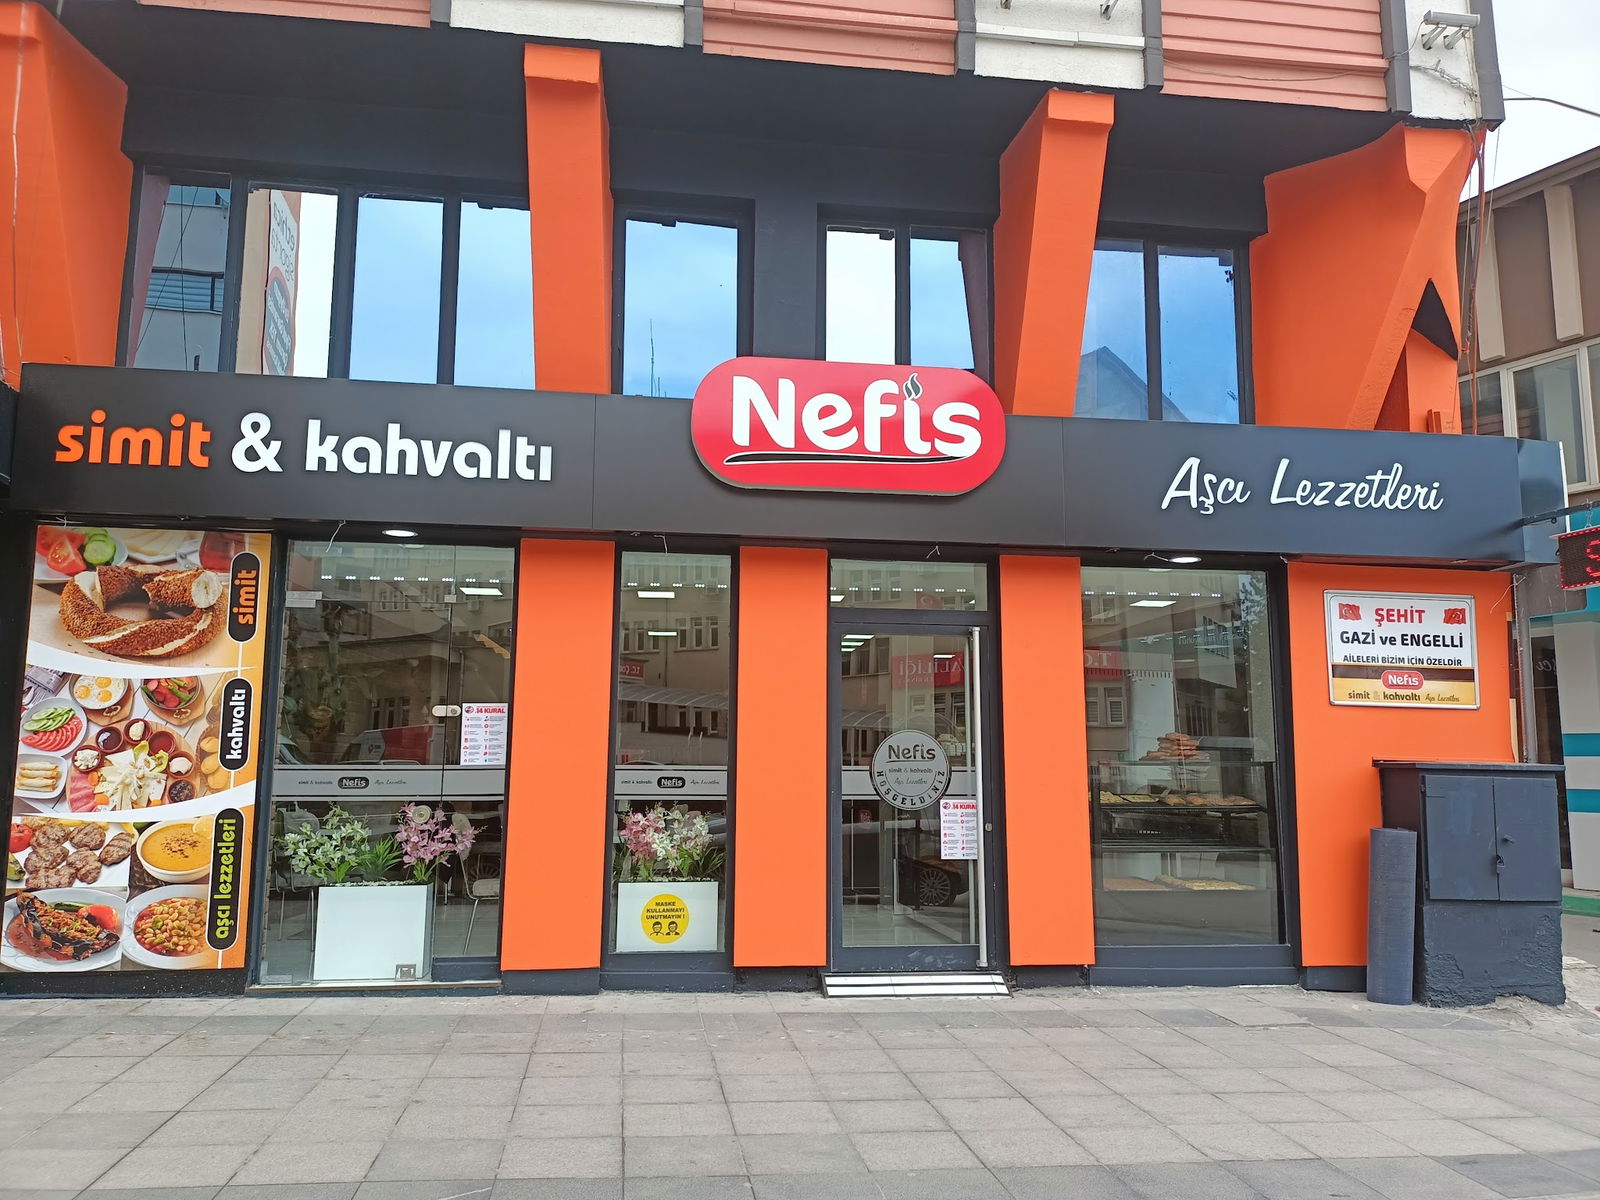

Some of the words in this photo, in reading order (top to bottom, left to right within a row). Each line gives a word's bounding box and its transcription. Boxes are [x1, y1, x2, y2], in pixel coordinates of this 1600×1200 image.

[732, 374, 983, 458] Nefis
[54, 408, 212, 468] simit
[231, 412, 284, 473] &
[305, 418, 553, 482] kahvaltı
[1161, 456, 1251, 515] Aşcı
[1270, 458, 1444, 511] Lezzetleri
[238, 569, 257, 625] simit
[1374, 605, 1426, 628] ŞEHİT
[1340, 629, 1376, 646] GAZİ
[1379, 635, 1397, 646] ve
[1401, 632, 1463, 648] ENGELLİ
[1343, 653, 1380, 664] AİLELERİ
[1381, 654, 1405, 665] BİZİM
[1407, 654, 1425, 666] İÇİN
[1426, 656, 1462, 667] ÖZELDİR
[1388, 674, 1419, 686] Nefis
[1348, 690, 1370, 700] simit
[1383, 691, 1420, 701] kahvaltı
[225, 688, 247, 760] kahvaltı
[888, 743, 936, 760] Nefis
[342, 778, 366, 787] Nefis
[661, 778, 683, 786] Nefis
[214, 818, 237, 899] lezzetleri
[214, 905, 234, 939] aşcı
